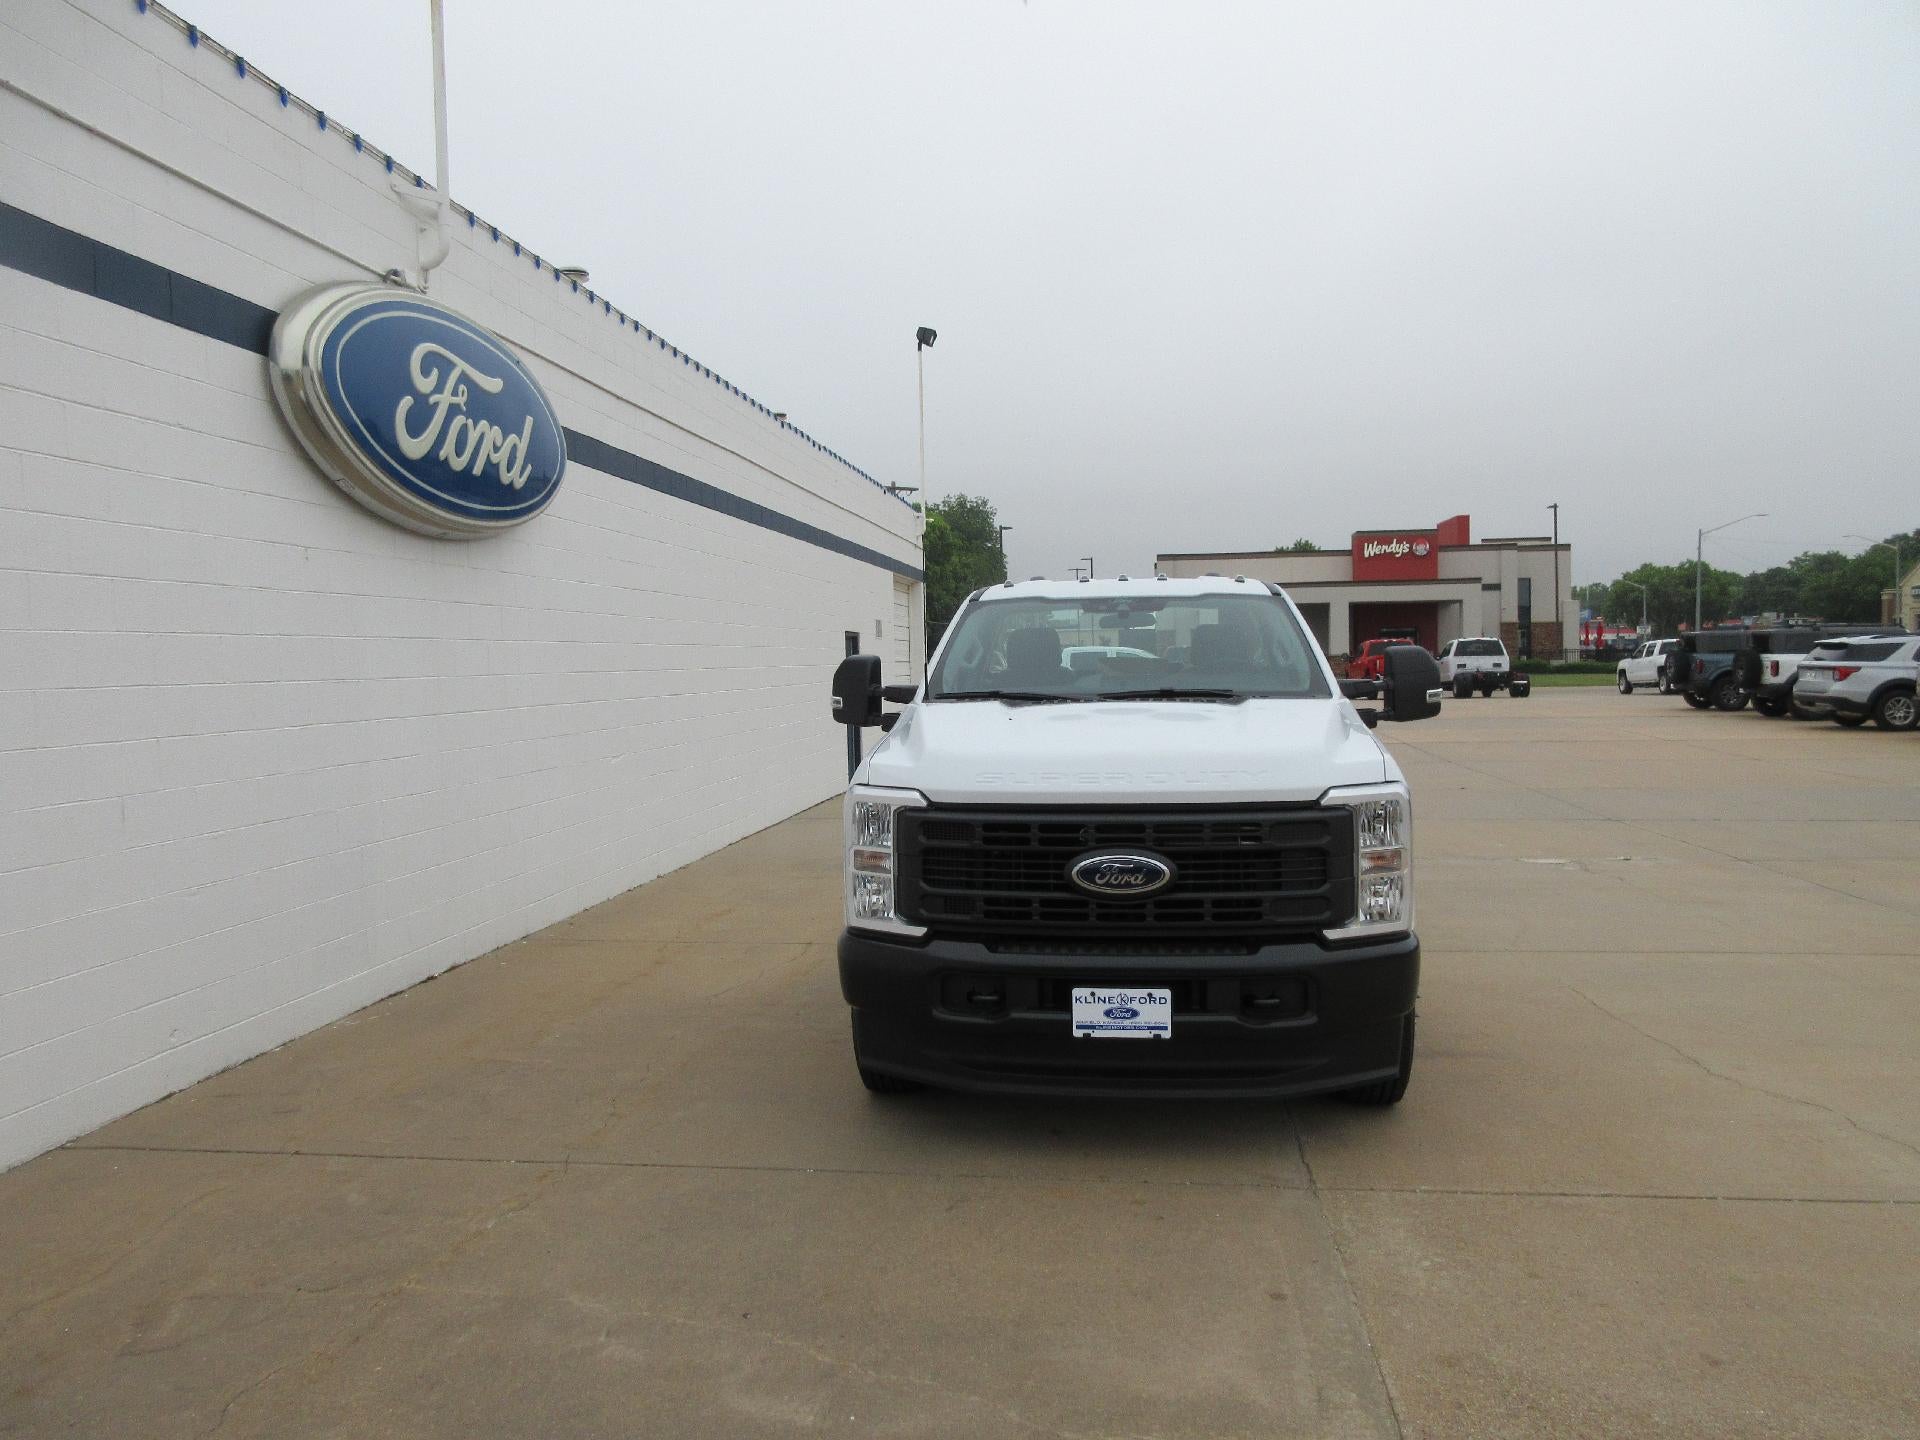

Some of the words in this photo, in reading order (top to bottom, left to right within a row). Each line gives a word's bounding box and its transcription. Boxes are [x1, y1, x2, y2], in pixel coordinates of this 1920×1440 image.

[395, 342, 533, 491] Ford
[1364, 538, 1410, 558] Wendy's
[1095, 863, 1147, 885] Ford
[1075, 995, 1115, 1004] KLINE
[1130, 996, 1167, 1004] FORD
[1110, 1008, 1132, 1018] Ford
